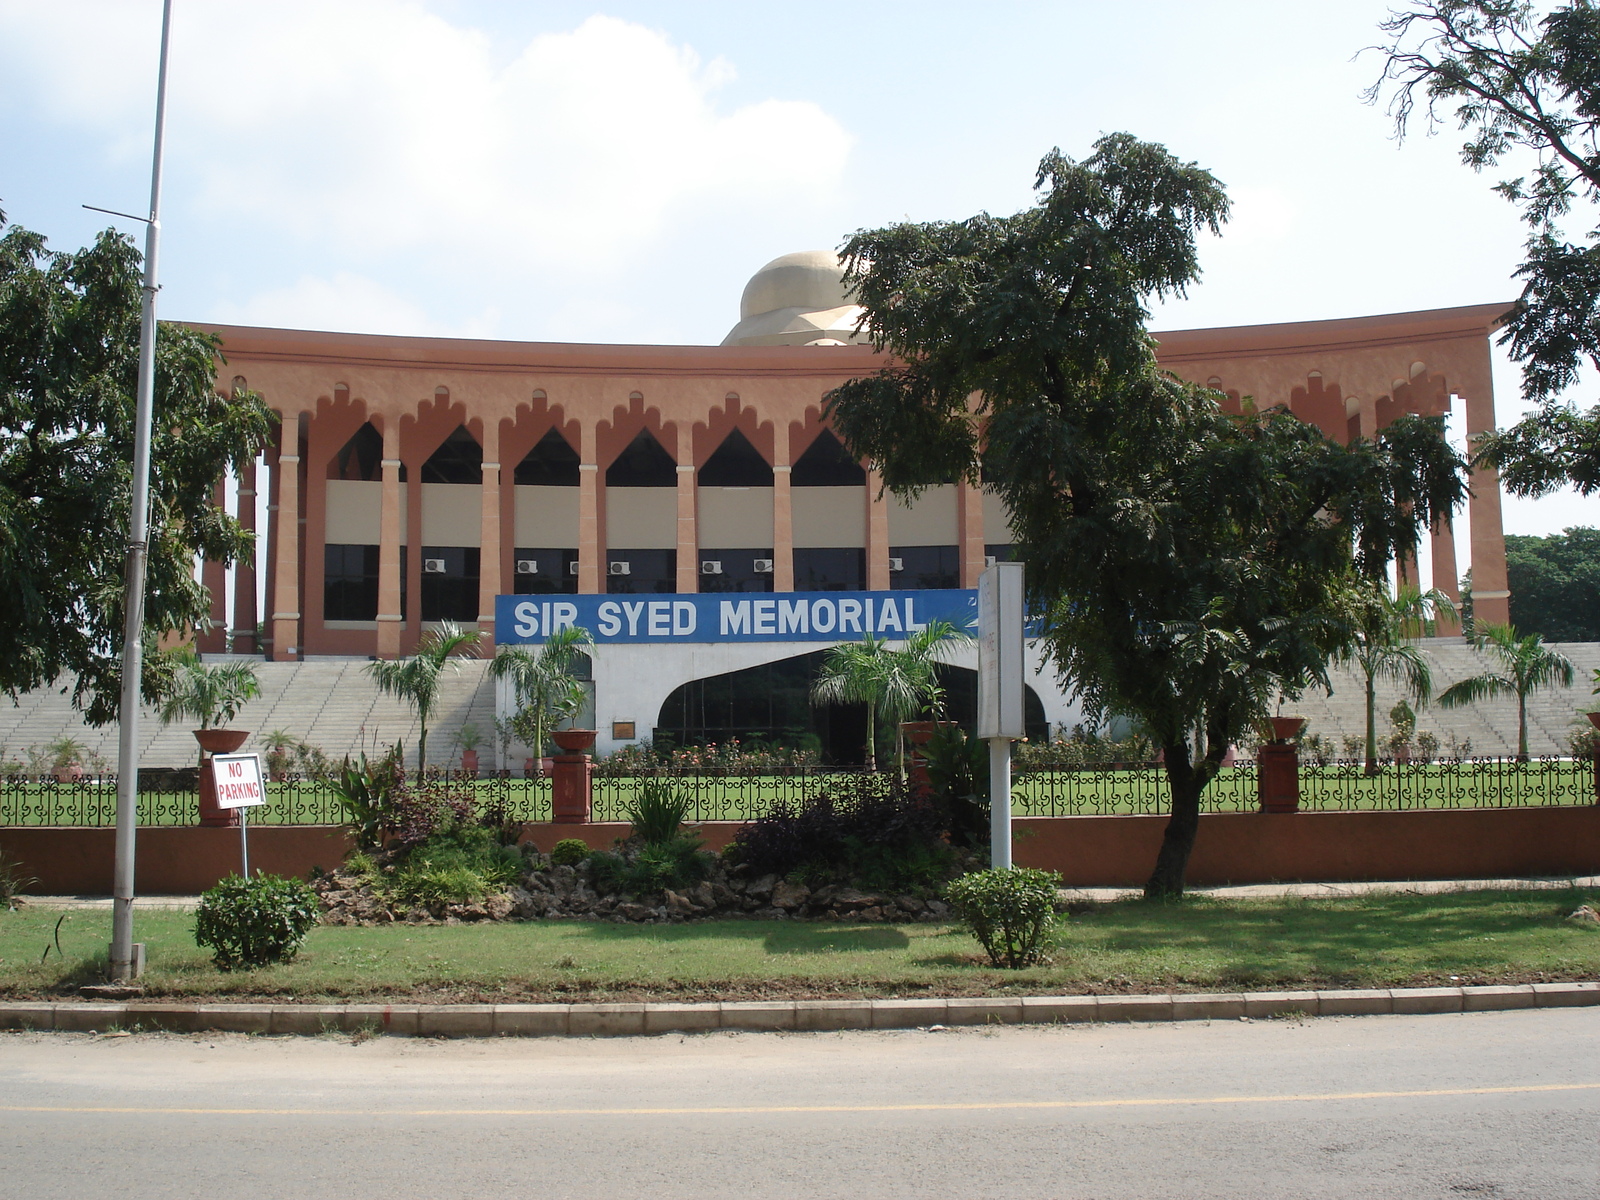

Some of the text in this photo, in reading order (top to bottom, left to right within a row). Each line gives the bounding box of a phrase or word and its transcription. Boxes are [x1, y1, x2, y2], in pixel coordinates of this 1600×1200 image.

[514, 602, 578, 638] SIR
[597, 601, 697, 637] SYED
[720, 597, 927, 635] MEMORIAL
[228, 762, 242, 778] NO
[218, 782, 259, 801] PARKING
